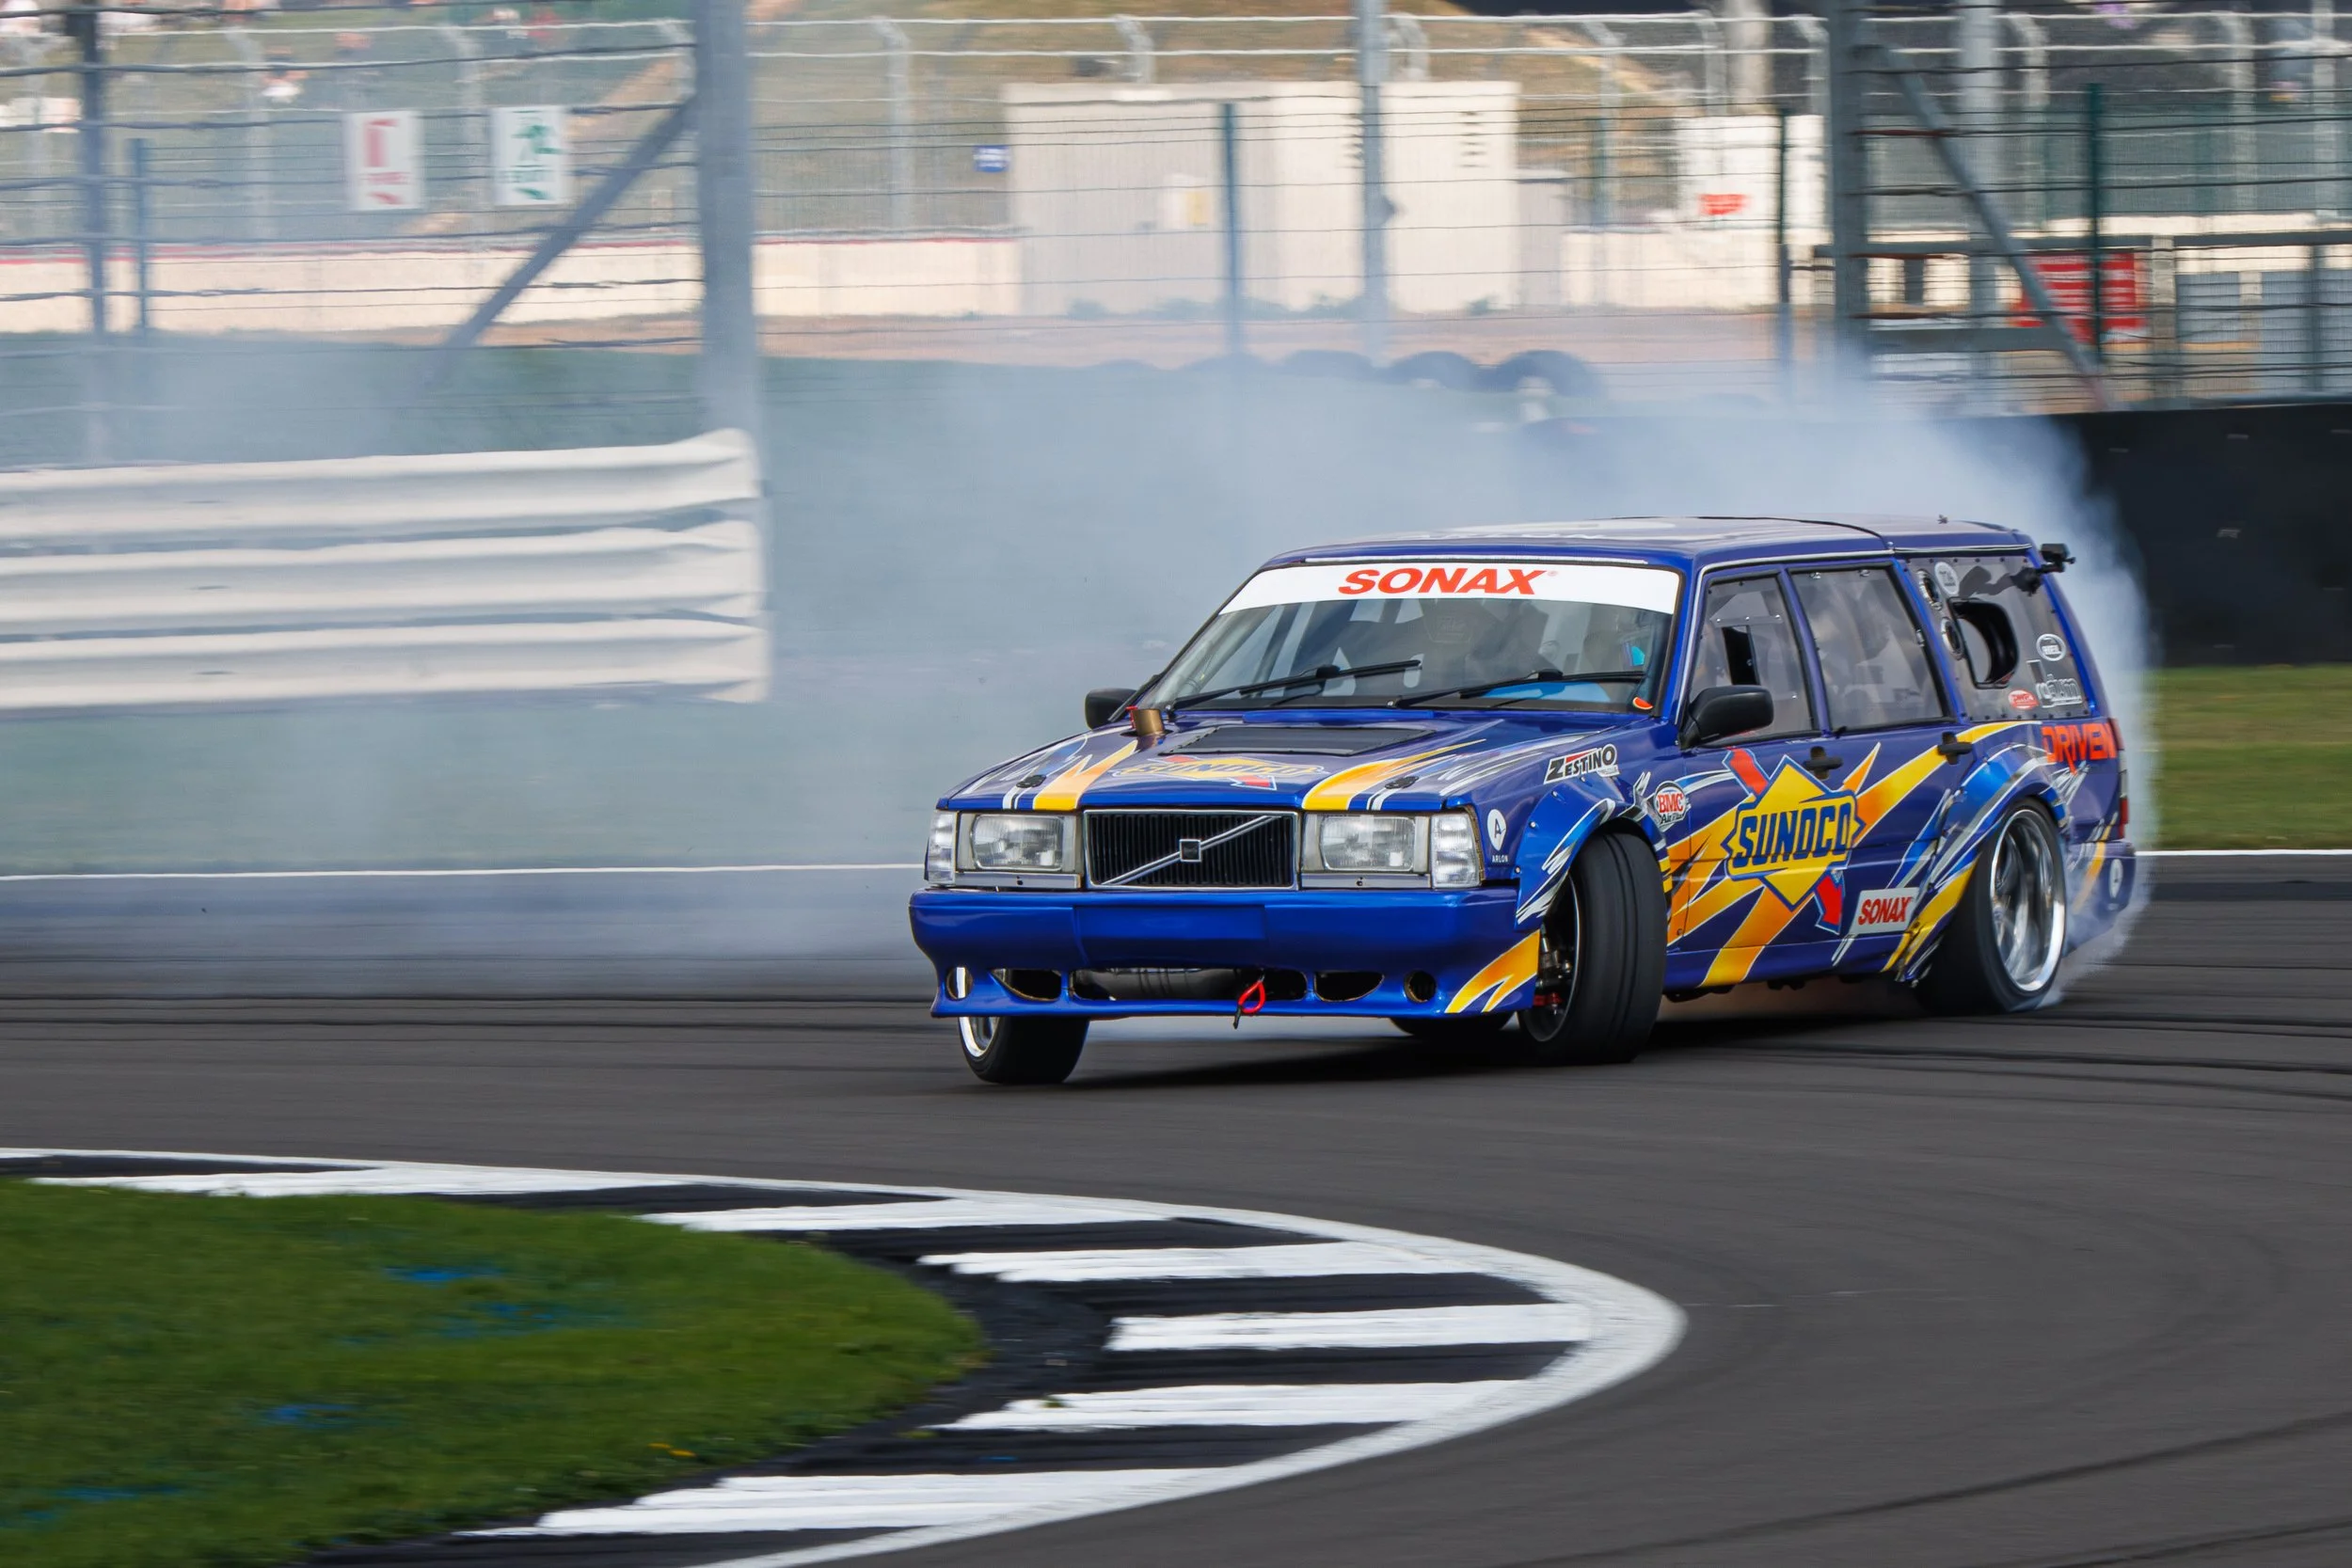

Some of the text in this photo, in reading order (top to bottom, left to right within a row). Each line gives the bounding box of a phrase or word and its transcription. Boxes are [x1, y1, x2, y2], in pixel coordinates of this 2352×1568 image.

[1338, 567, 1547, 594] SONAX
[2041, 722, 2117, 775] DRIVEN
[1546, 746, 1615, 782] ZESTINO
[1658, 793, 1684, 814] BMC
[1732, 801, 1852, 869] SUNOCO
[1491, 854, 1509, 863] ARLON
[1858, 897, 1912, 926] SONAX
